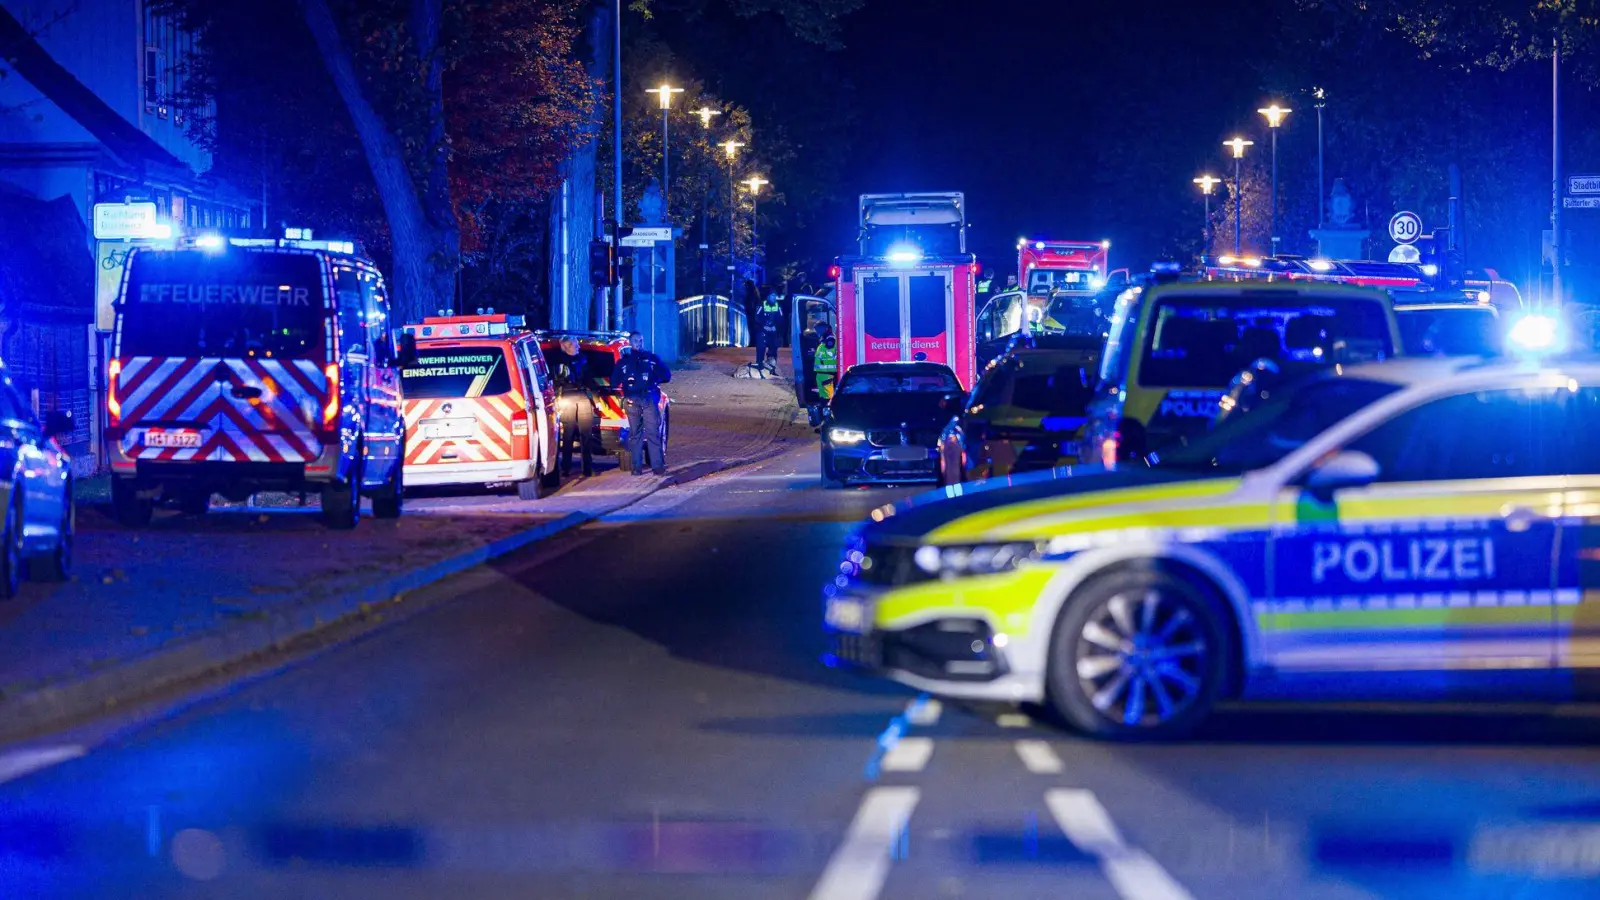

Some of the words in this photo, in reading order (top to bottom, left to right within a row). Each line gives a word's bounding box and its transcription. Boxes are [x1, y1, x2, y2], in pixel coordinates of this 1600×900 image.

[1397, 220, 1415, 235] 30
[157, 284, 309, 306] FEUERWEHR
[447, 355, 493, 364] HANNOVER
[403, 366, 486, 378] EINSATZLEITUNG
[1311, 537, 1496, 583] POLIZEI
